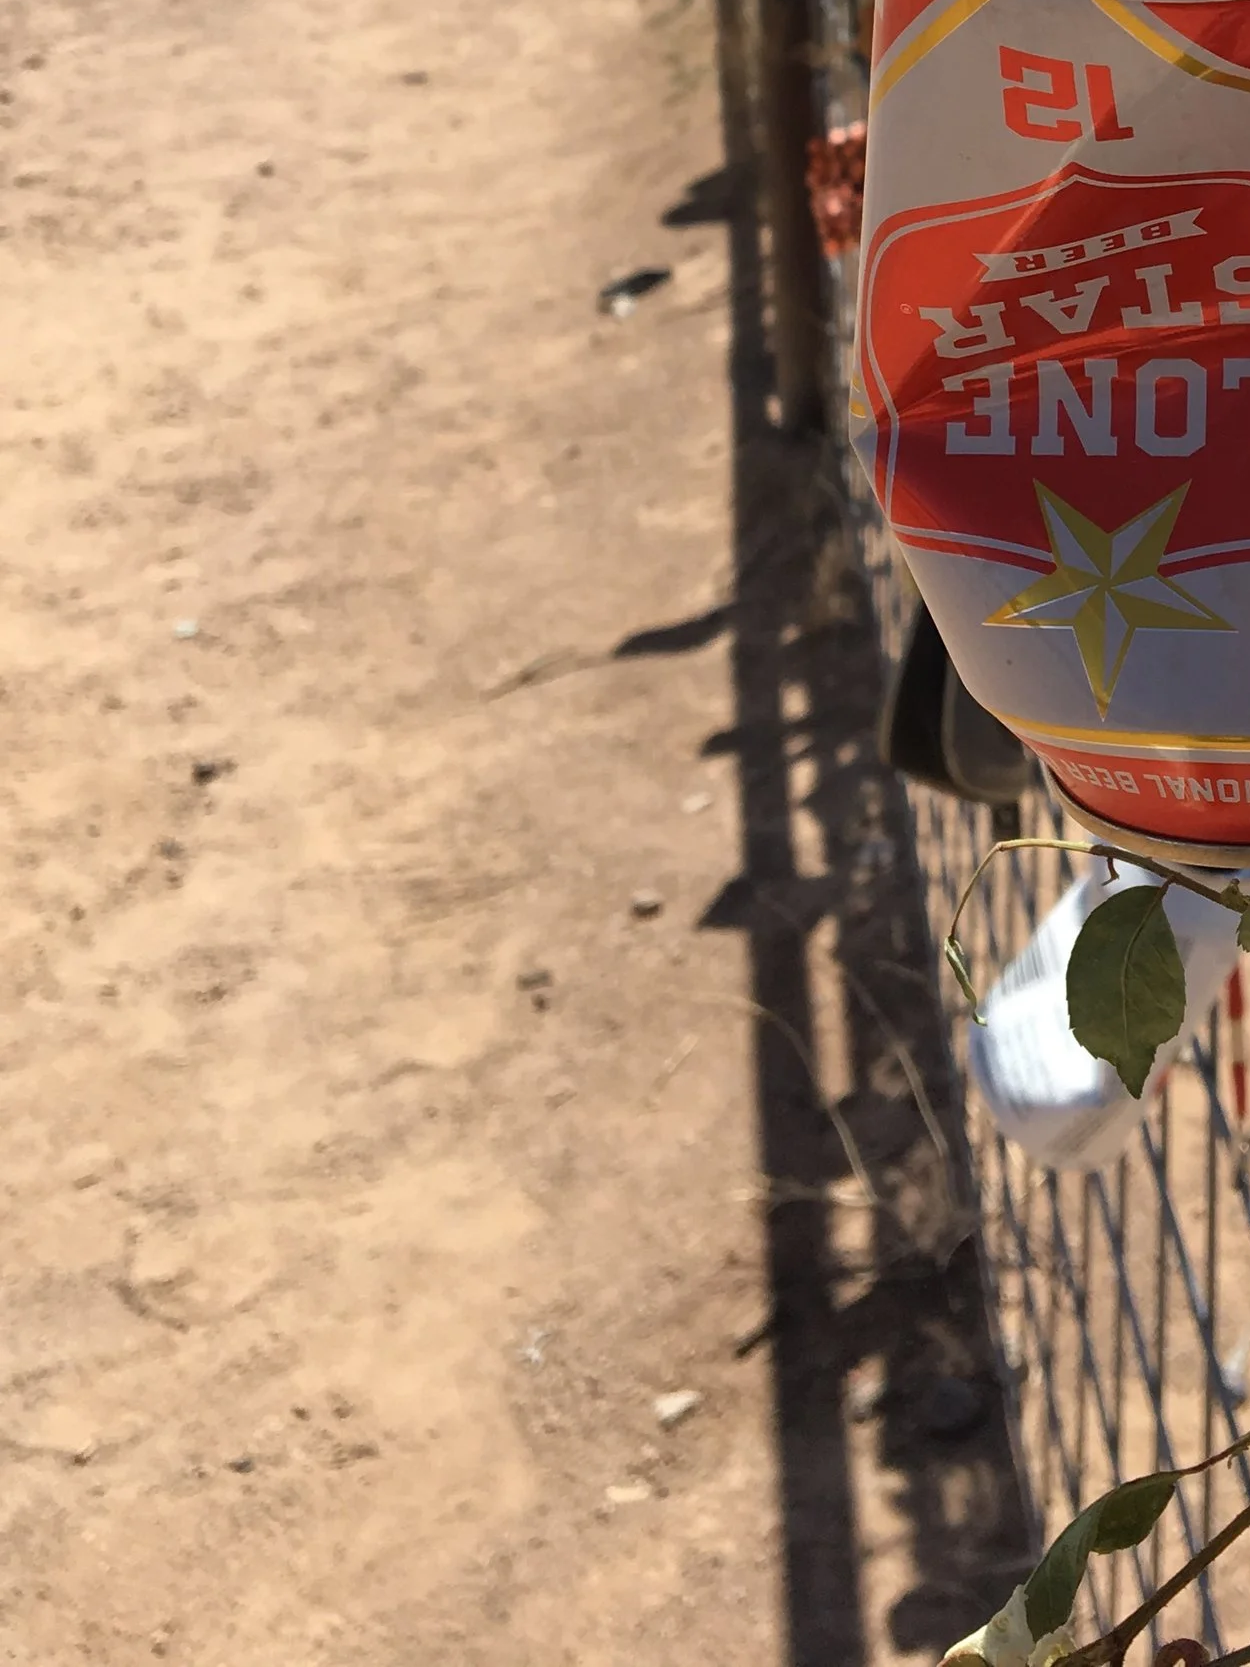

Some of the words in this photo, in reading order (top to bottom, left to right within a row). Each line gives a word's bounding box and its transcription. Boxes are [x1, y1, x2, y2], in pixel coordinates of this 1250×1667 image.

[998, 45, 1135, 143] 12
[1012, 221, 1172, 274] BEER
[1066, 761, 1140, 795] BEER
